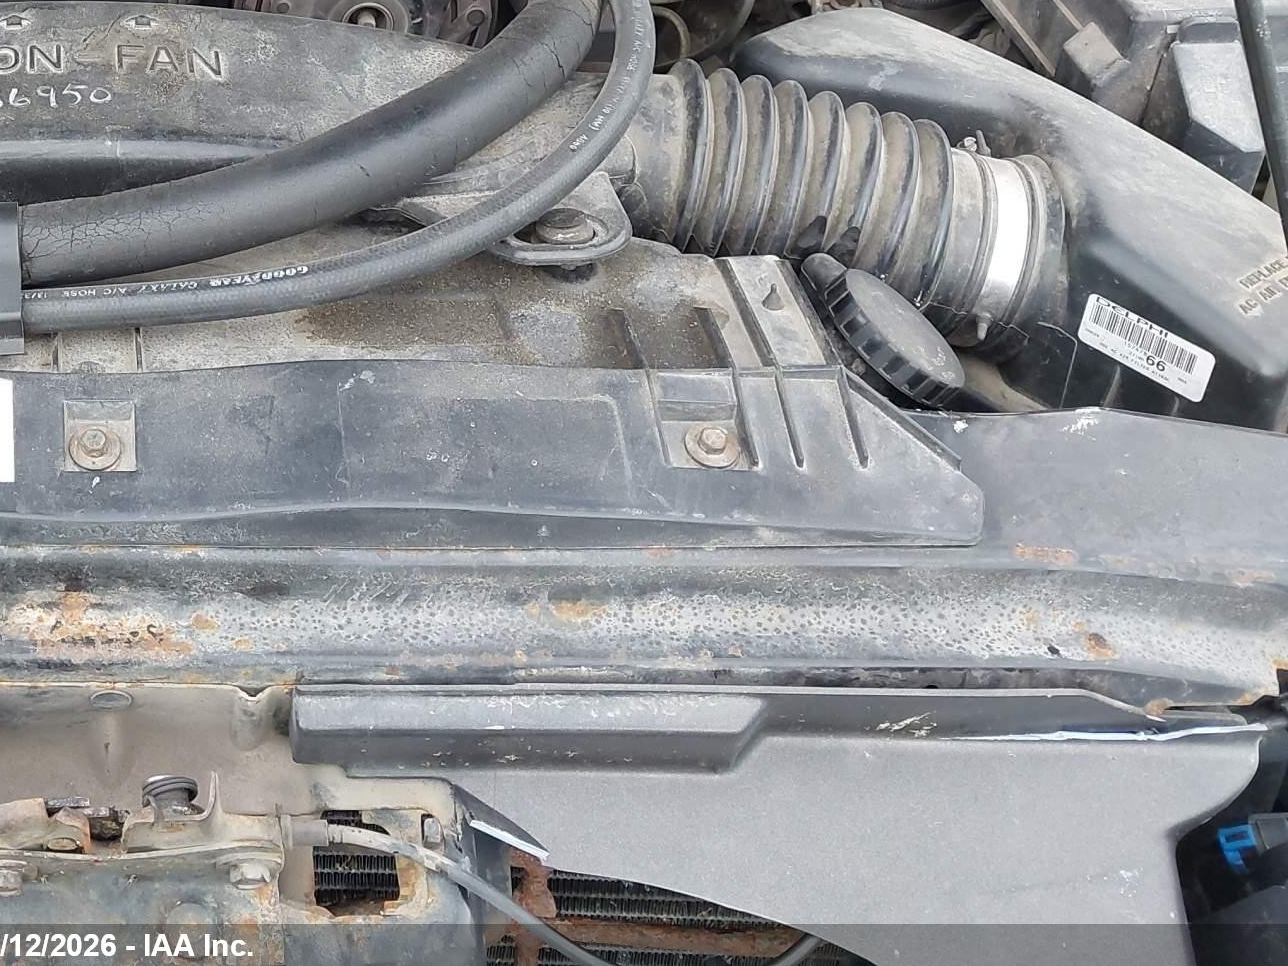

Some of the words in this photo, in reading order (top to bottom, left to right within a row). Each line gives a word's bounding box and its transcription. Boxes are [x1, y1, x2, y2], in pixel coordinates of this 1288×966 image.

[116, 43, 223, 79] FAN
[210, 265, 309, 287] GOODYEAR
[62, 288, 96, 299] HOSE
[104, 286, 127, 296] A/C
[137, 280, 198, 293] GALAXY
[1096, 296, 1169, 338] DELPHI
[1146, 355, 1167, 372] 66
